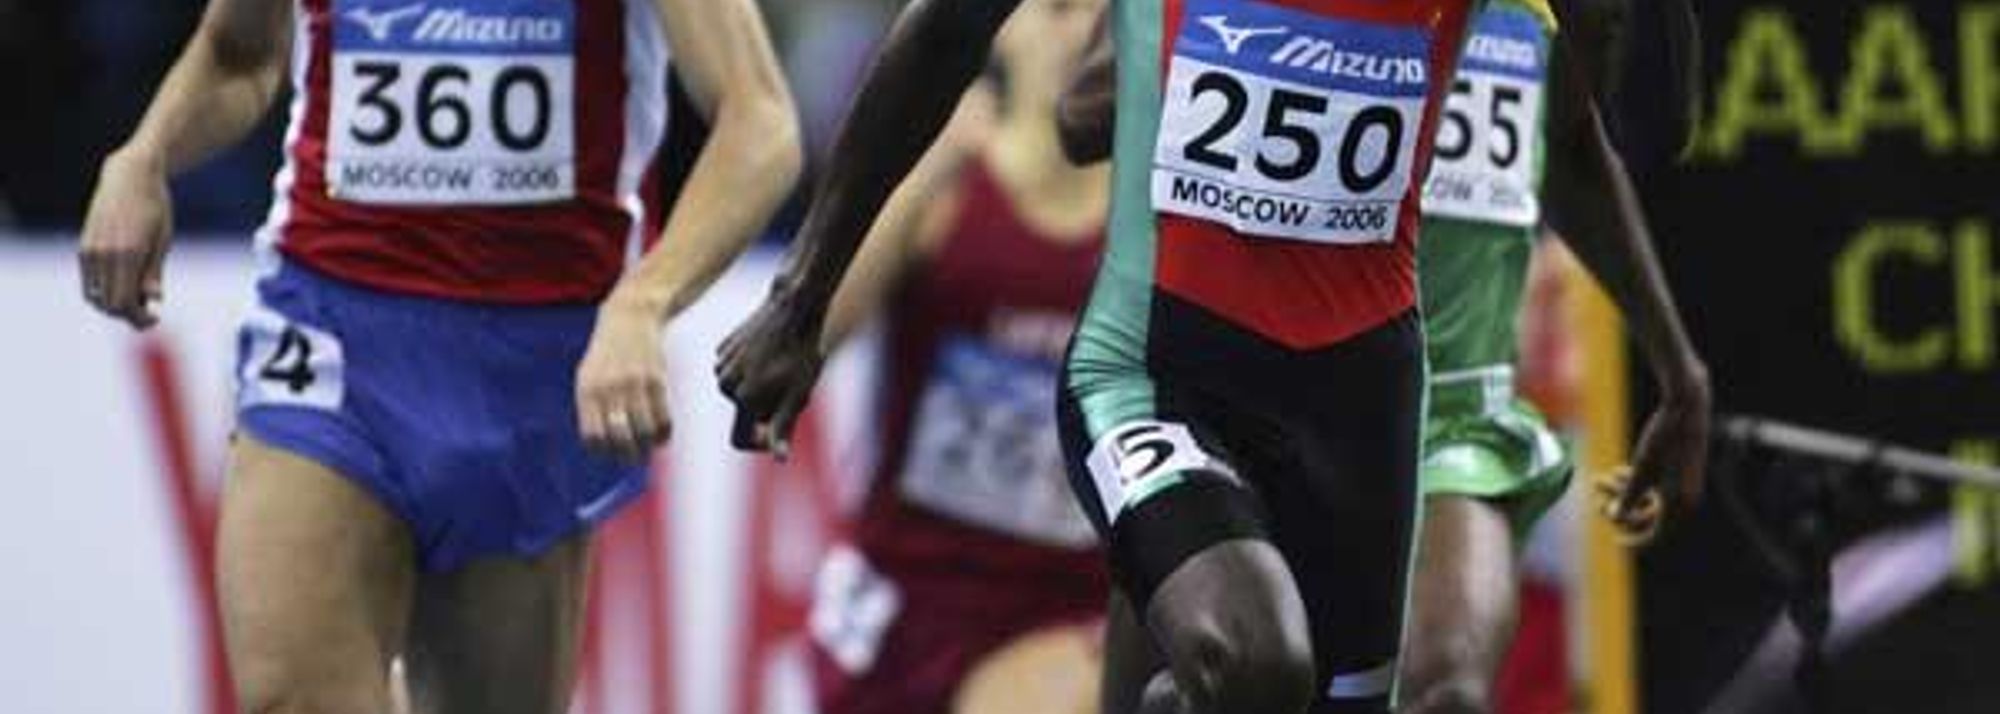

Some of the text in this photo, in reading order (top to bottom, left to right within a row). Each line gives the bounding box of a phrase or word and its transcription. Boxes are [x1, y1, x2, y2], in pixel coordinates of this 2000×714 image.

[349, 60, 552, 152] 360
[1183, 71, 1404, 194] 250
[342, 162, 560, 191] MOSCOW 2006
[1171, 177, 1388, 231] MOSCOW 2006
[259, 325, 316, 395] 4
[1116, 425, 1176, 487] 5
